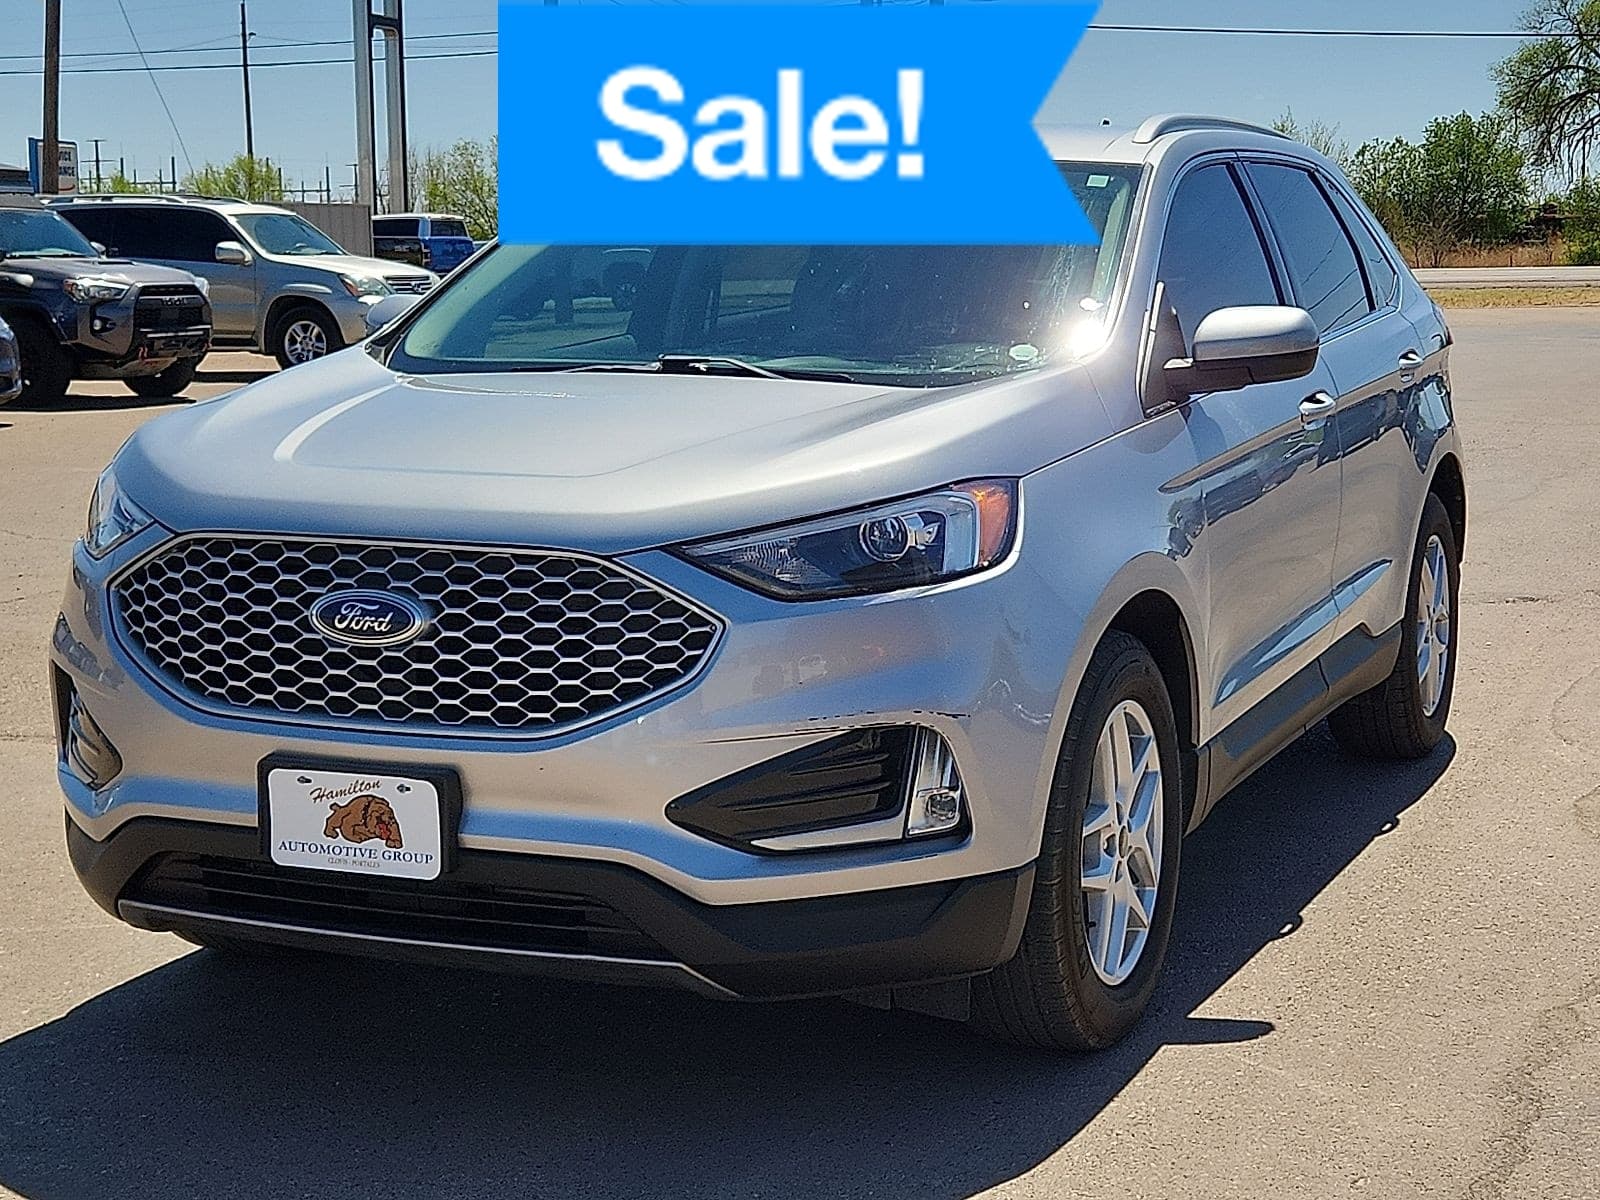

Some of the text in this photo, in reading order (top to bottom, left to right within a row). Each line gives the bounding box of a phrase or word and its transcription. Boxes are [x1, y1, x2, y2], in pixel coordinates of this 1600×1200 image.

[335, 602, 394, 632] Ford
[309, 779, 381, 803] Hamilton
[278, 840, 434, 865] AUTOMOTIVE GROUP
